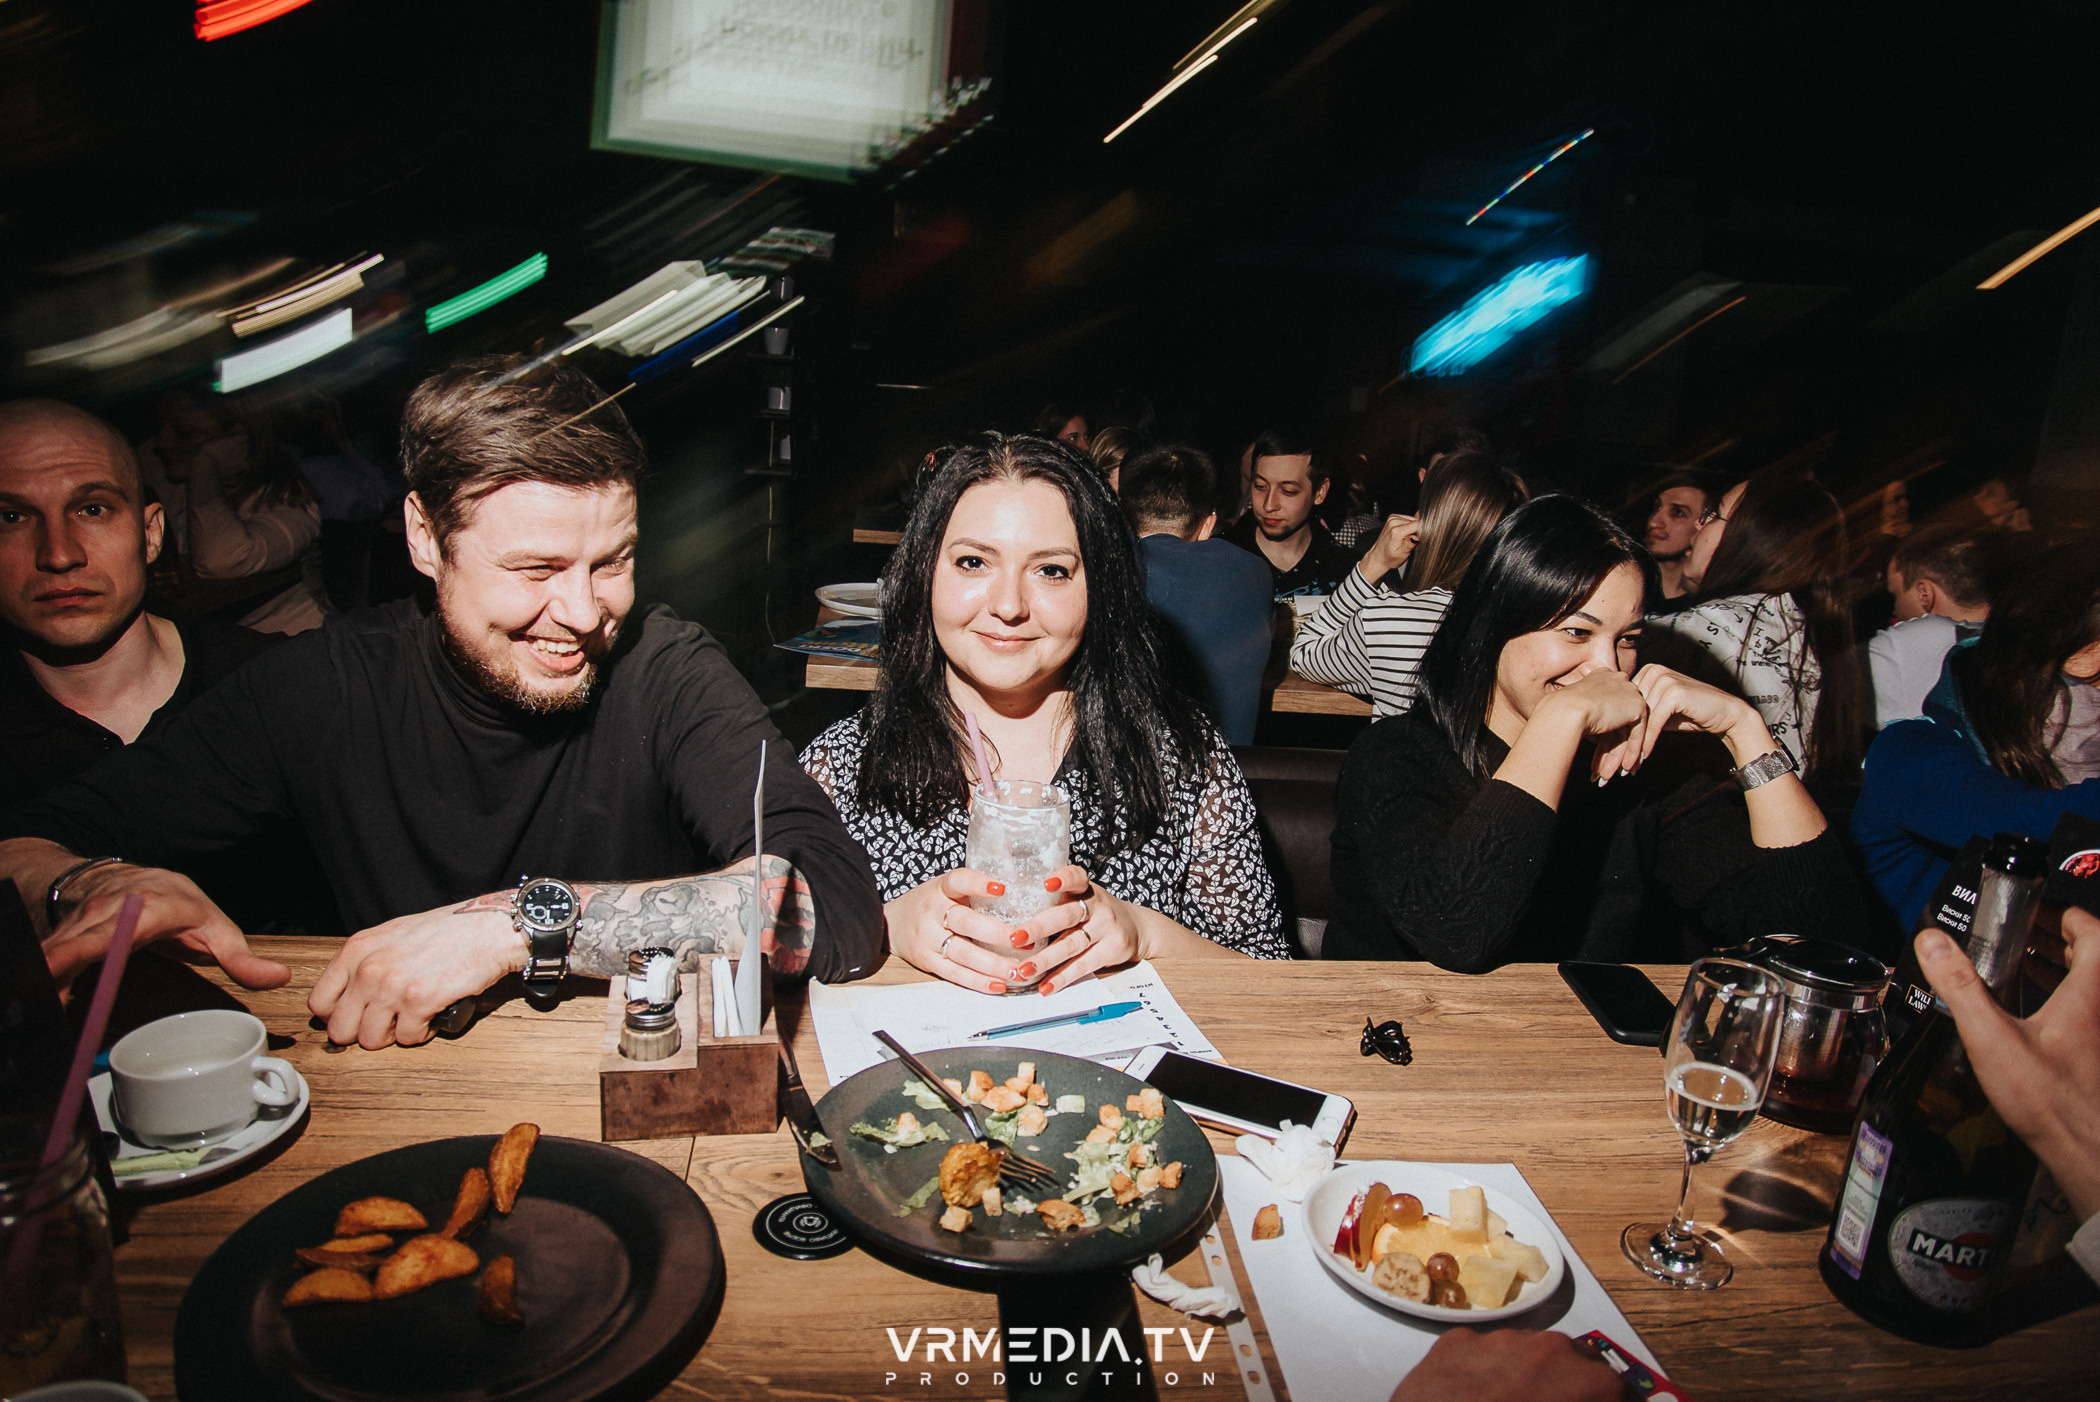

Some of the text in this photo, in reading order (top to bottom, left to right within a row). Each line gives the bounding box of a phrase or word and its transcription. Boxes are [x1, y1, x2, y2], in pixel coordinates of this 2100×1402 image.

[1941, 904, 1962, 919] Виски
[1936, 912, 1967, 932] Виски 50
